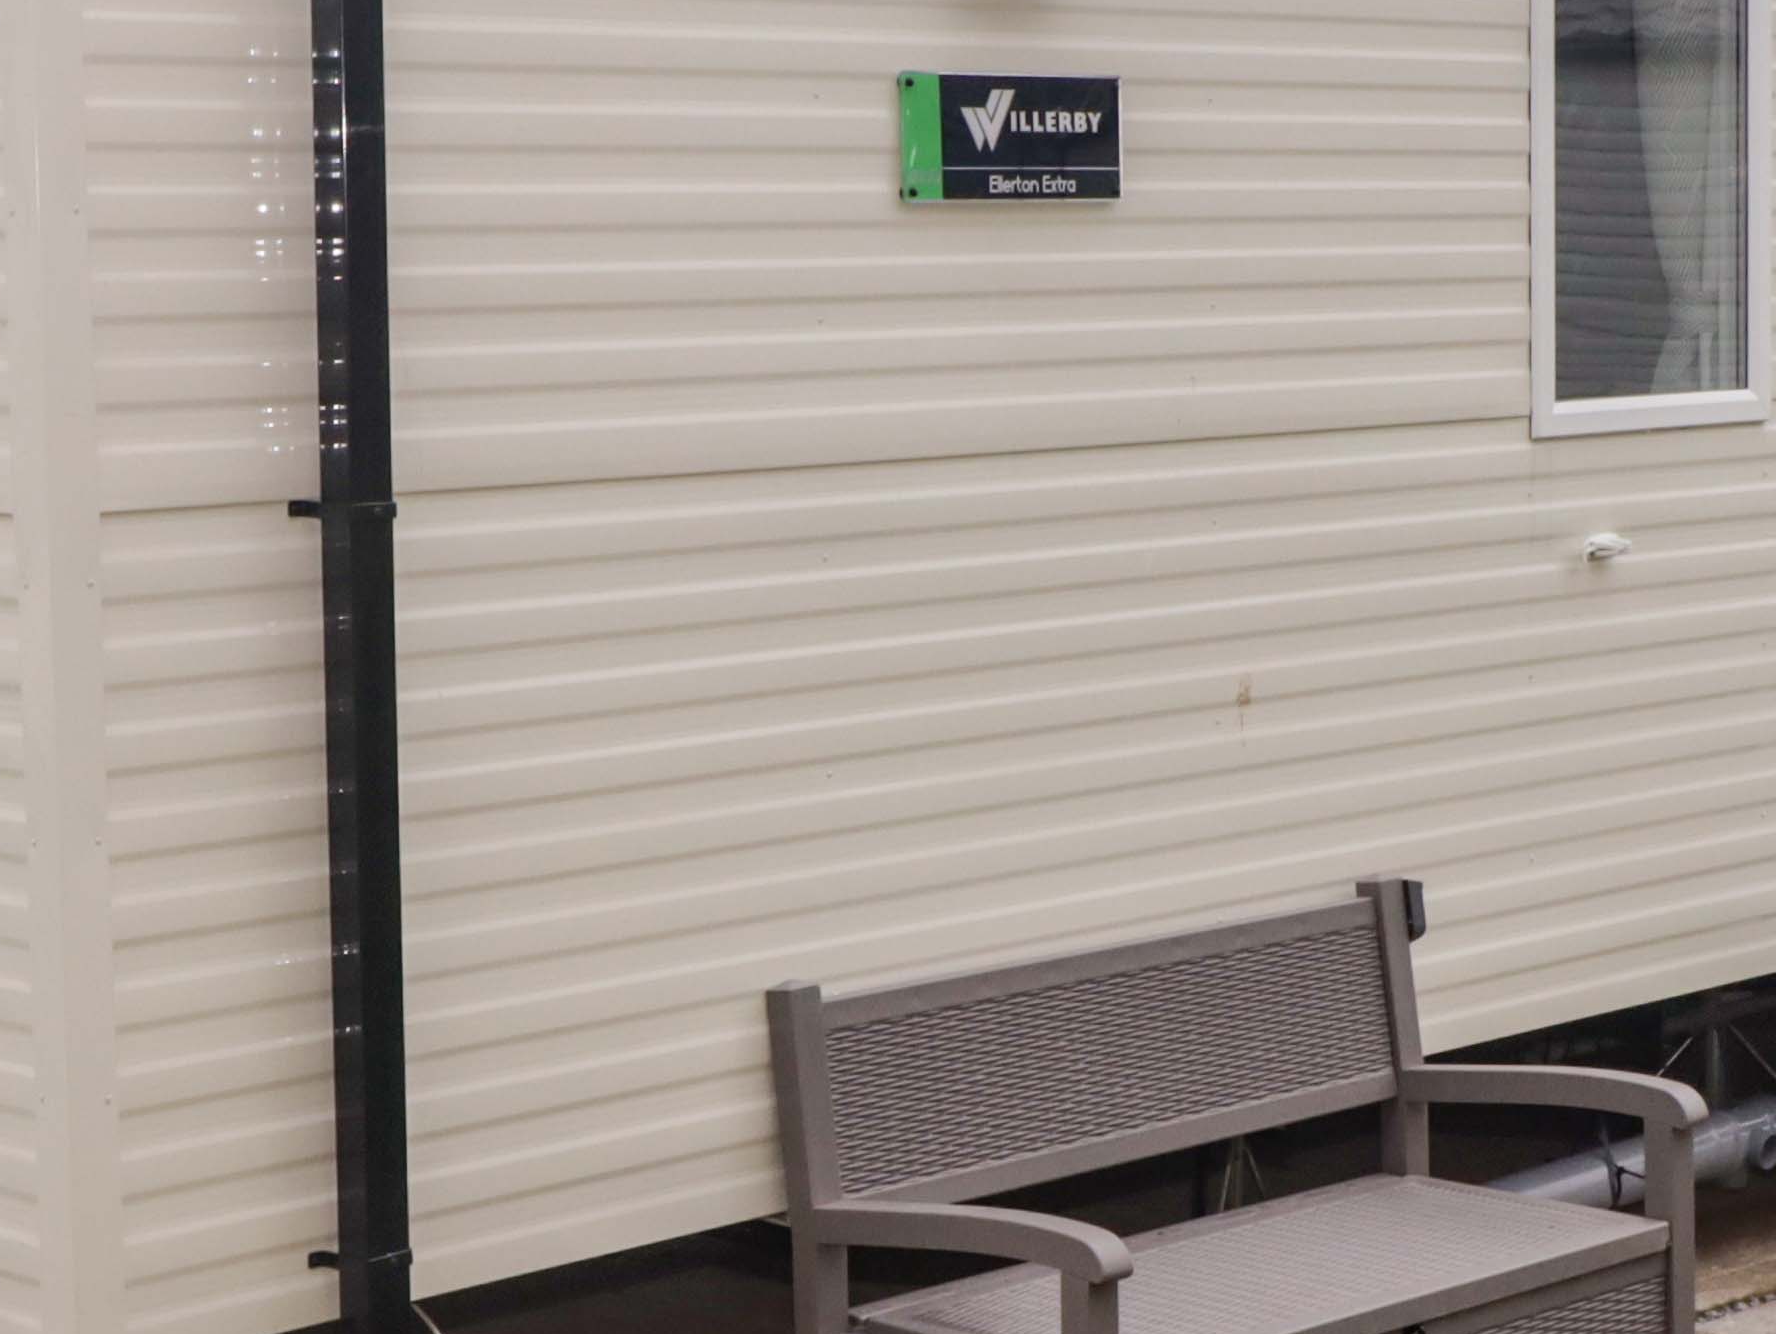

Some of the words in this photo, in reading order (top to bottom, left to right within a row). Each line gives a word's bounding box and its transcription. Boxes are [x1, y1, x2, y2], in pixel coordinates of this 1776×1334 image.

[960, 89, 1102, 152] WILLERBY
[988, 174, 1039, 193] Ellerton
[1042, 174, 1077, 193] Extra
